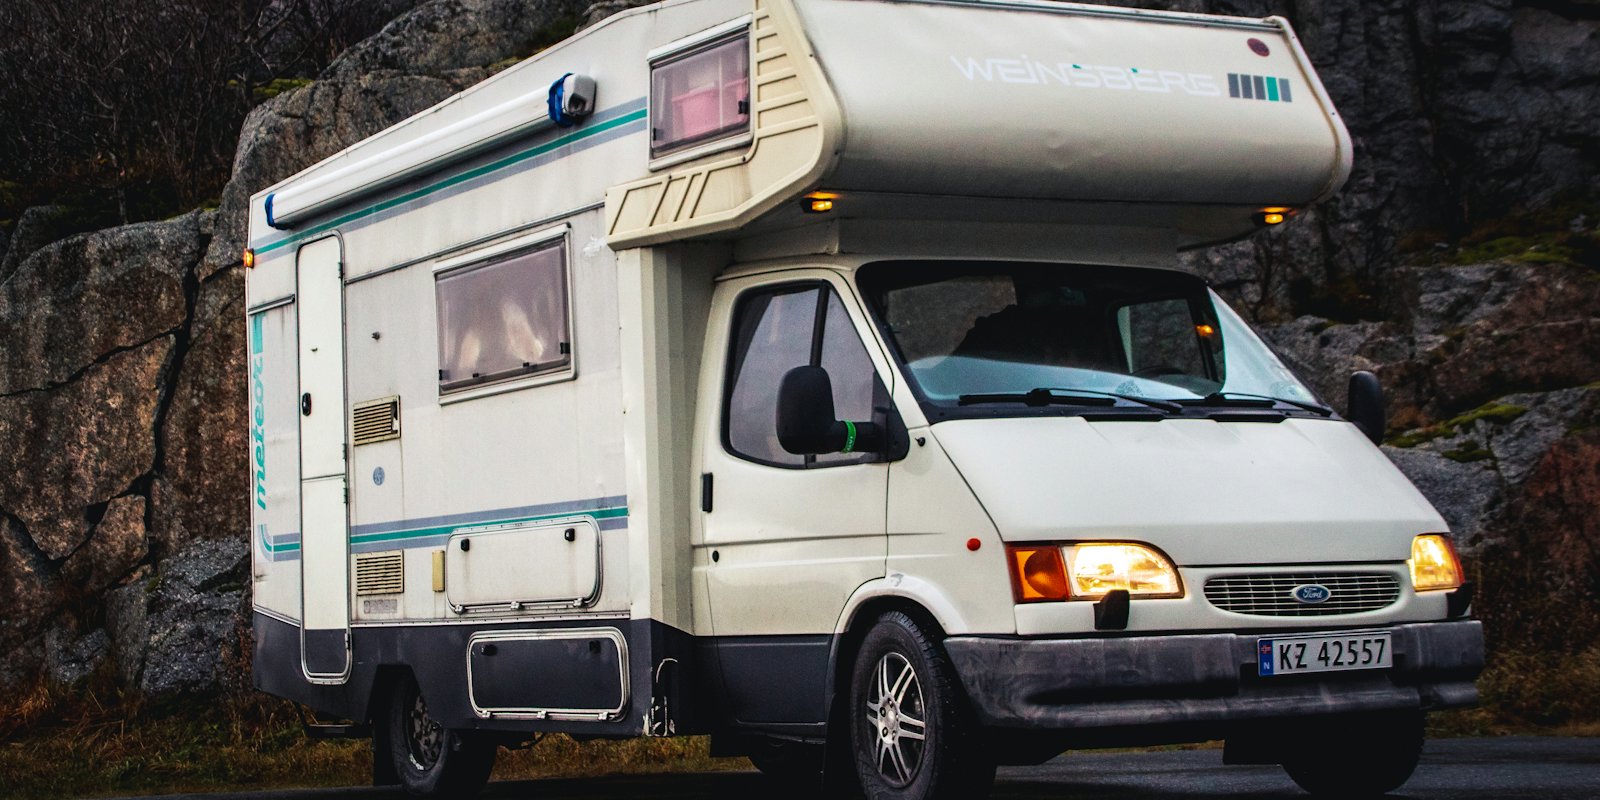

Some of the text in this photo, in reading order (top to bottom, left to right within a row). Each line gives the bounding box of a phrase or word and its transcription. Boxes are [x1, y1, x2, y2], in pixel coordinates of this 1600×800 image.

[252, 357, 267, 511] meteor
[1302, 587, 1323, 599] Ford
[1279, 638, 1386, 671] KZ 42557
[1263, 661, 1271, 671] N
